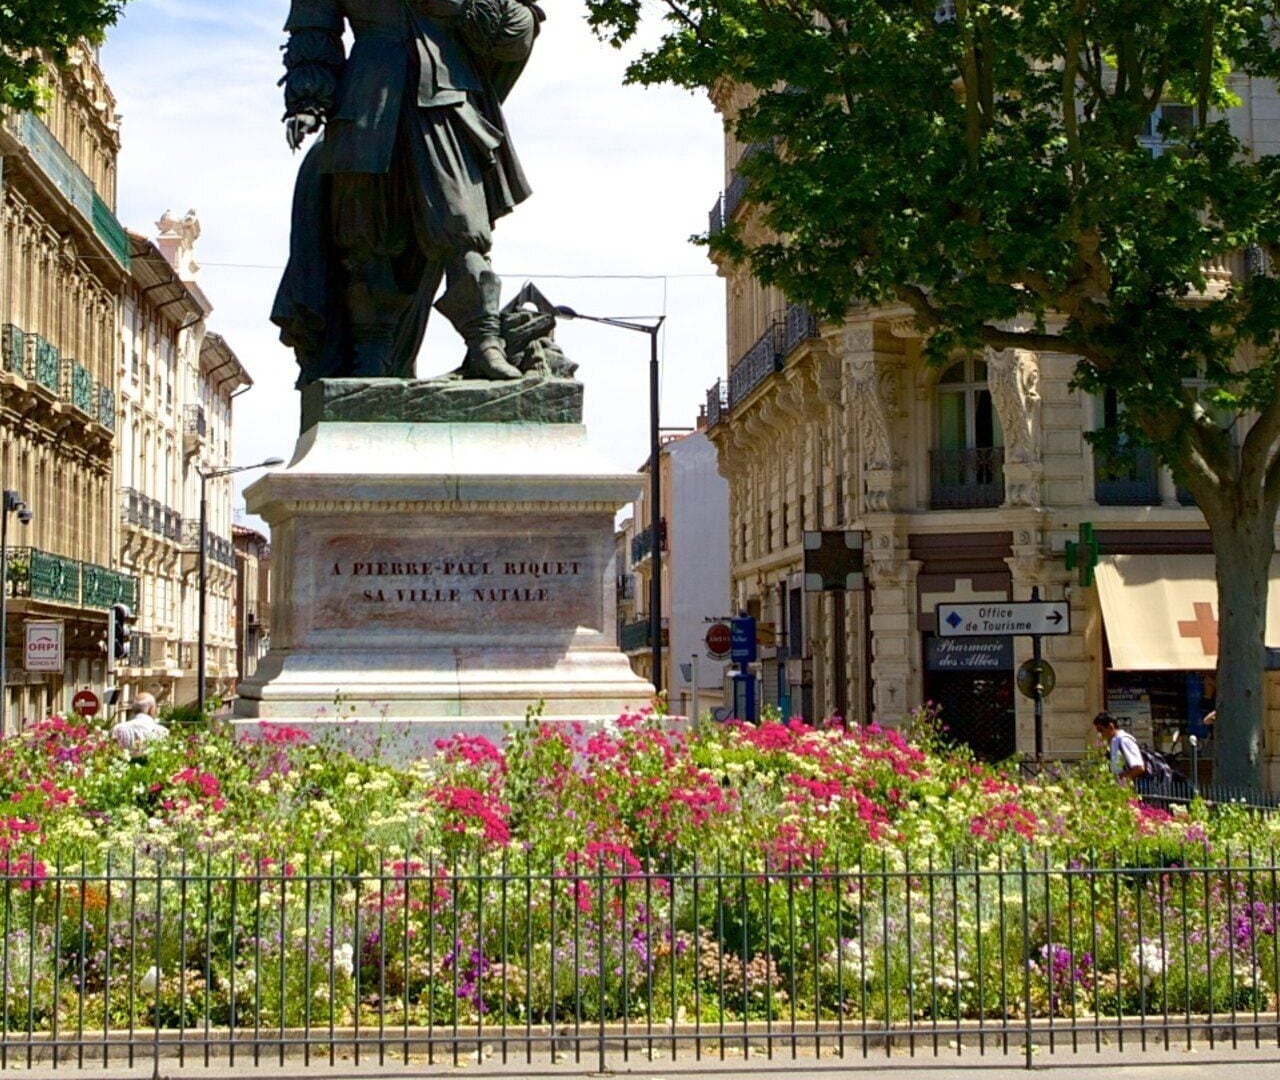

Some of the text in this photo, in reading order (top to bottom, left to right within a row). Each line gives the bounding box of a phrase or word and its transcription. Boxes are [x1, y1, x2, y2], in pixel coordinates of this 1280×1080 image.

[330, 562, 582, 578] A PIERRE-PAUL RIQUET
[363, 589, 385, 602] SA
[395, 589, 460, 602] VILLE
[978, 607, 1013, 619] Office
[965, 620, 1032, 632] de Tourisme
[28, 643, 59, 652] ORPI
[936, 639, 1004, 653] Pharmacie
[939, 654, 1000, 667] des Allées
